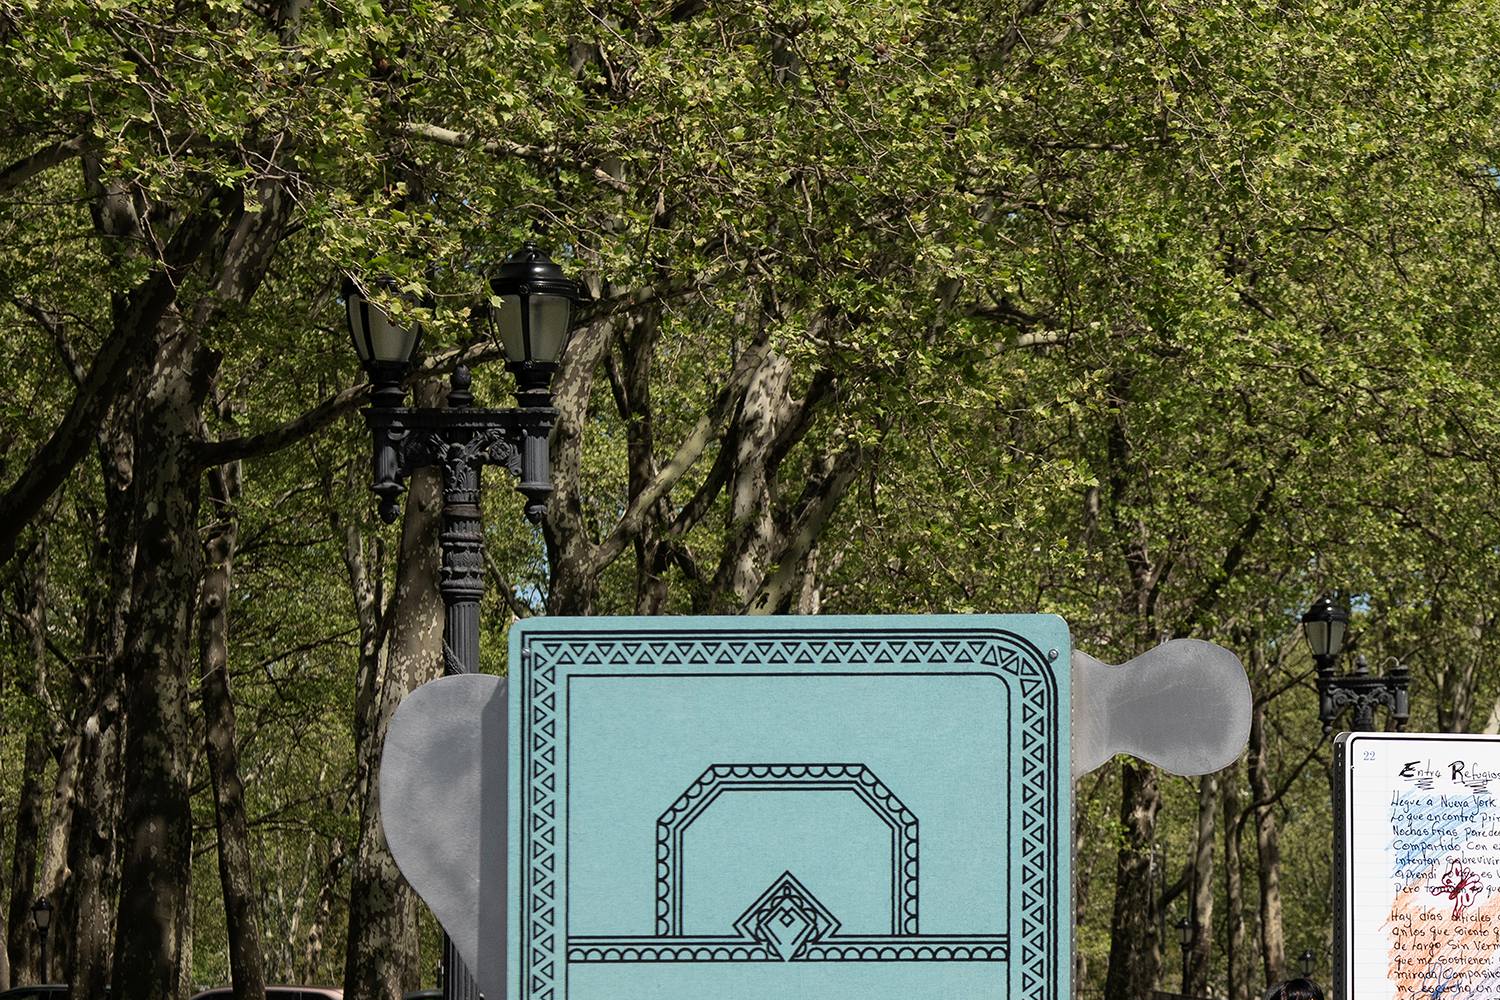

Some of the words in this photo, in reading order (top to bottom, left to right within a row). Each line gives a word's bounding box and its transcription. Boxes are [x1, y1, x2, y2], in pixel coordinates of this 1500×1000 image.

[1363, 751, 1376, 761] 22
[1441, 795, 1469, 808] Nueva
[1473, 795, 1497, 815] York
[1391, 910, 1412, 928] Hay
